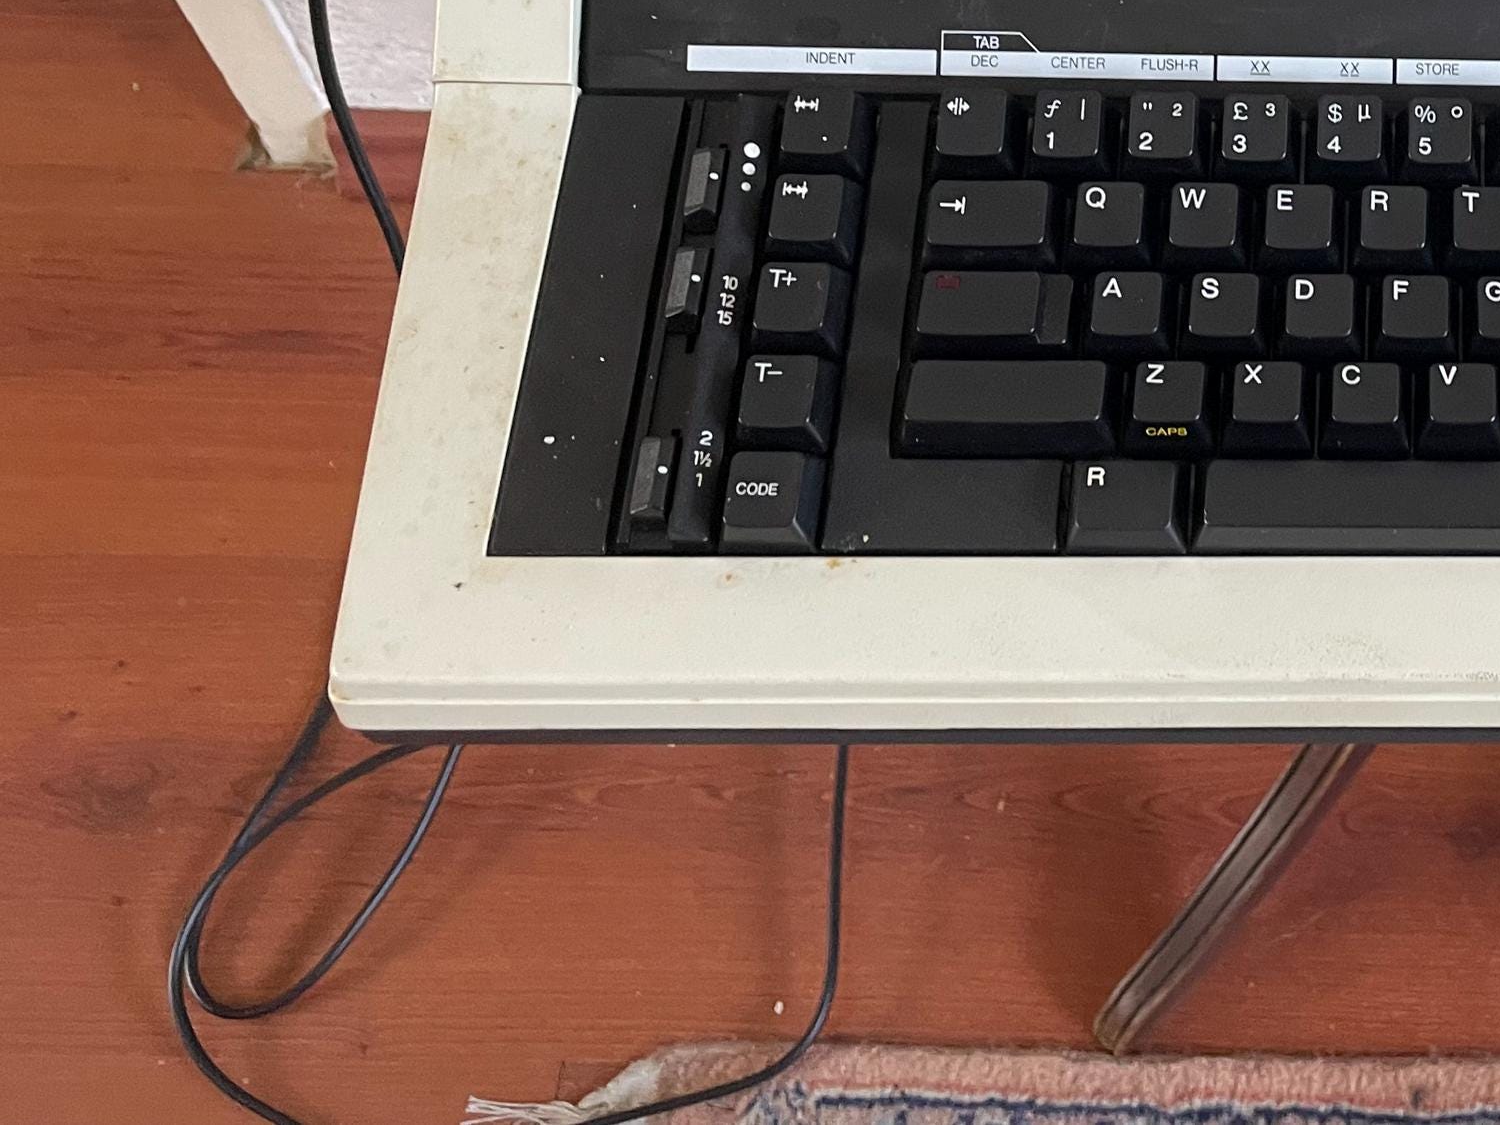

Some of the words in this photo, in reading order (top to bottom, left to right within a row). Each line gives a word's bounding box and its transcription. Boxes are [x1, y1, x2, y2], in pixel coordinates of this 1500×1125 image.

[973, 35, 1000, 49] TAB
[806, 52, 855, 65] INDENT
[971, 55, 999, 67] DEC
[1051, 57, 1106, 70] CENTER
[1141, 58, 1198, 71] FLUSH-R
[1415, 63, 1459, 76] STORE
[1233, 102, 1248, 120] £
[1328, 104, 1342, 123] $
[1414, 105, 1436, 123] %
[1046, 131, 1054, 149] 1
[1139, 132, 1152, 150] 2
[1232, 134, 1246, 153] 3
[1327, 135, 1341, 153] 4
[1418, 136, 1432, 155] 5
[1085, 188, 1106, 210] Q
[1179, 188, 1206, 209] W
[1277, 190, 1293, 210] E
[1370, 191, 1389, 211] R
[1462, 192, 1479, 213] T
[722, 276, 738, 290] 10
[769, 269, 796, 287] T+
[1102, 278, 1122, 298] A
[1201, 279, 1219, 299] S
[1295, 280, 1314, 300] D
[1392, 281, 1409, 301] F
[720, 293, 735, 308] 12
[717, 310, 732, 325] 15
[1146, 364, 1165, 384] Z
[1243, 365, 1263, 384] X
[1342, 365, 1361, 385] C
[1438, 365, 1457, 386] V
[699, 431, 713, 446] 2
[1145, 426, 1188, 436] CAPS
[696, 473, 702, 487] 1
[1087, 467, 1106, 486] R
[735, 482, 779, 496] CODE
